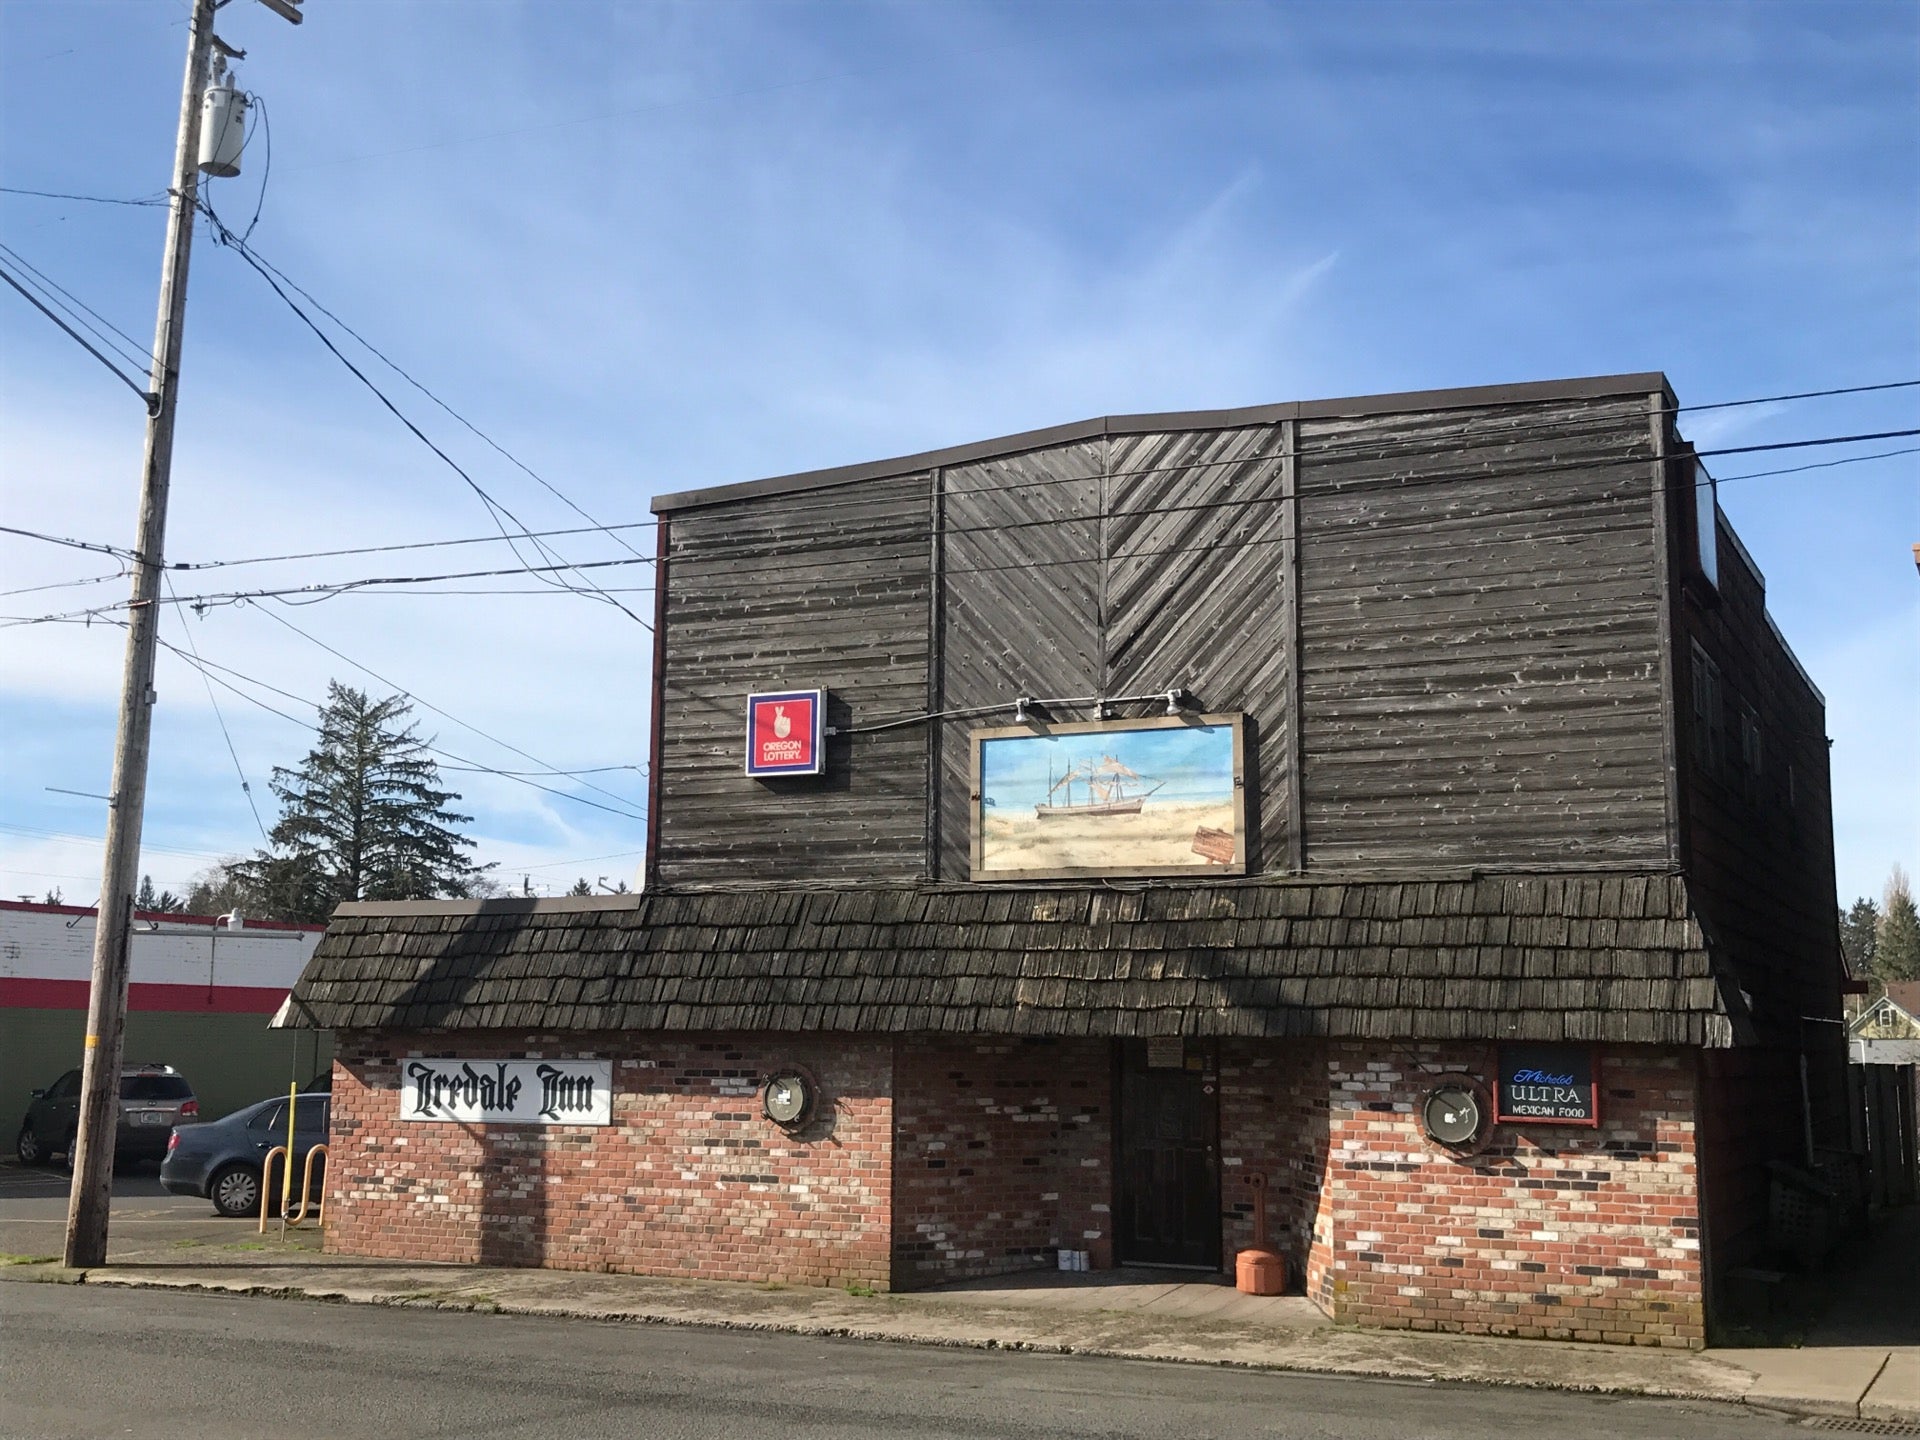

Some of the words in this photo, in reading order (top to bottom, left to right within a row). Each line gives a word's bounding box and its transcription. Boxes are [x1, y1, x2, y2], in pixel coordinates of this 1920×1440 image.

[763, 740, 802, 752] OREGON
[1513, 1069, 1574, 1085] Michelob
[408, 1062, 522, 1118] Iredale
[536, 1063, 595, 1121] Inn
[1510, 1085, 1582, 1103] ULTRA
[1512, 1104, 1554, 1116] MEXICAN
[1558, 1107, 1585, 1118] FOOD
